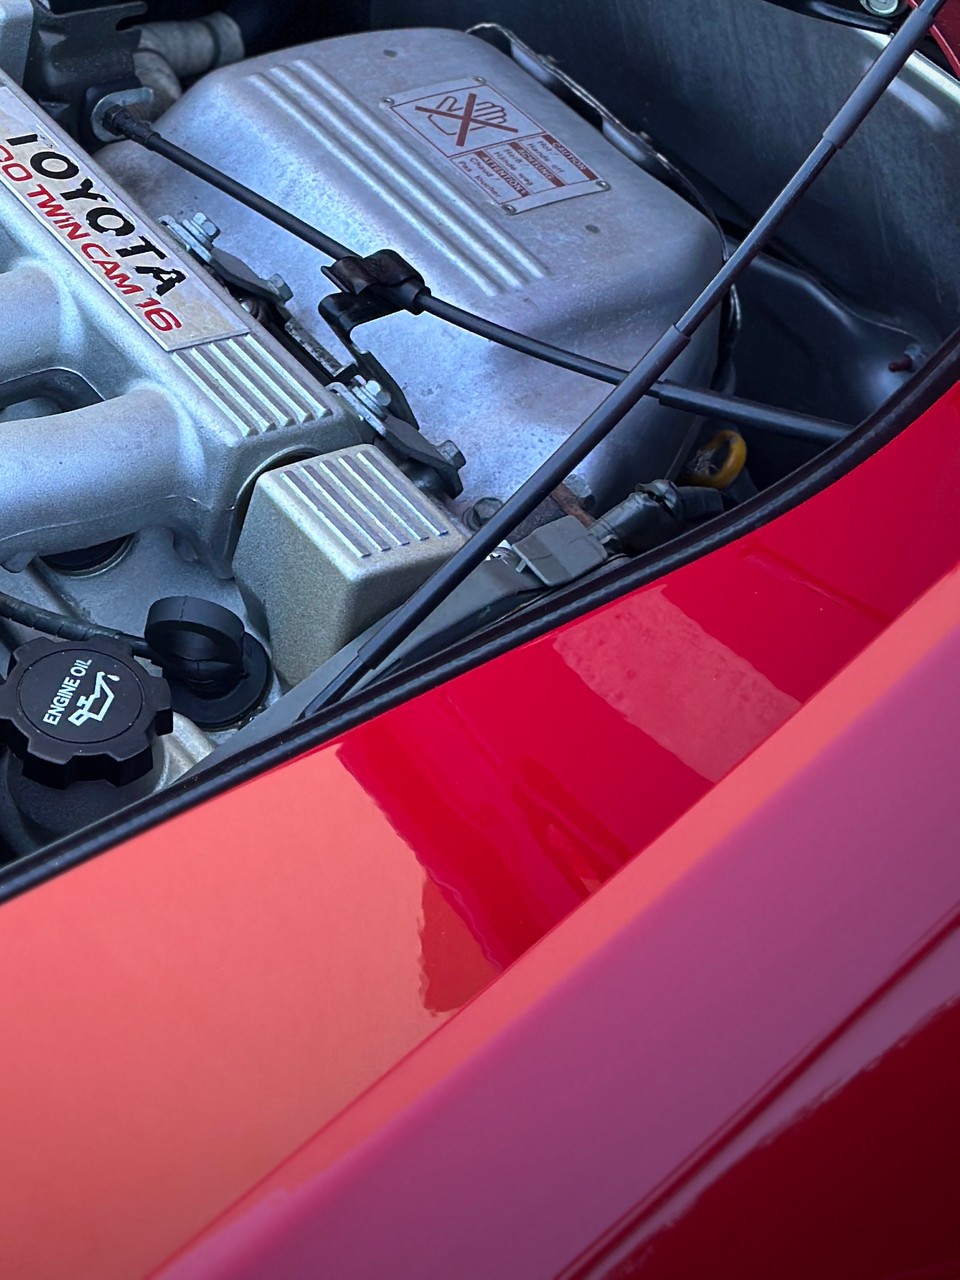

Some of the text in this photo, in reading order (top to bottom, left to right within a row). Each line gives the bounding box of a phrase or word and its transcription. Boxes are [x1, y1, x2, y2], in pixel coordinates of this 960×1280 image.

[470, 157, 494, 178] Chaud
[517, 148, 554, 179] ACHTUNG
[527, 142, 550, 162] Hands
[552, 142, 587, 171] CAUTION
[458, 160, 501, 197] Pas toucher
[27, 183, 91, 241] TWIN
[81, 242, 144, 296] CAM
[135, 297, 183, 332] 16
[42, 658, 93, 726] ENGINE OIL
